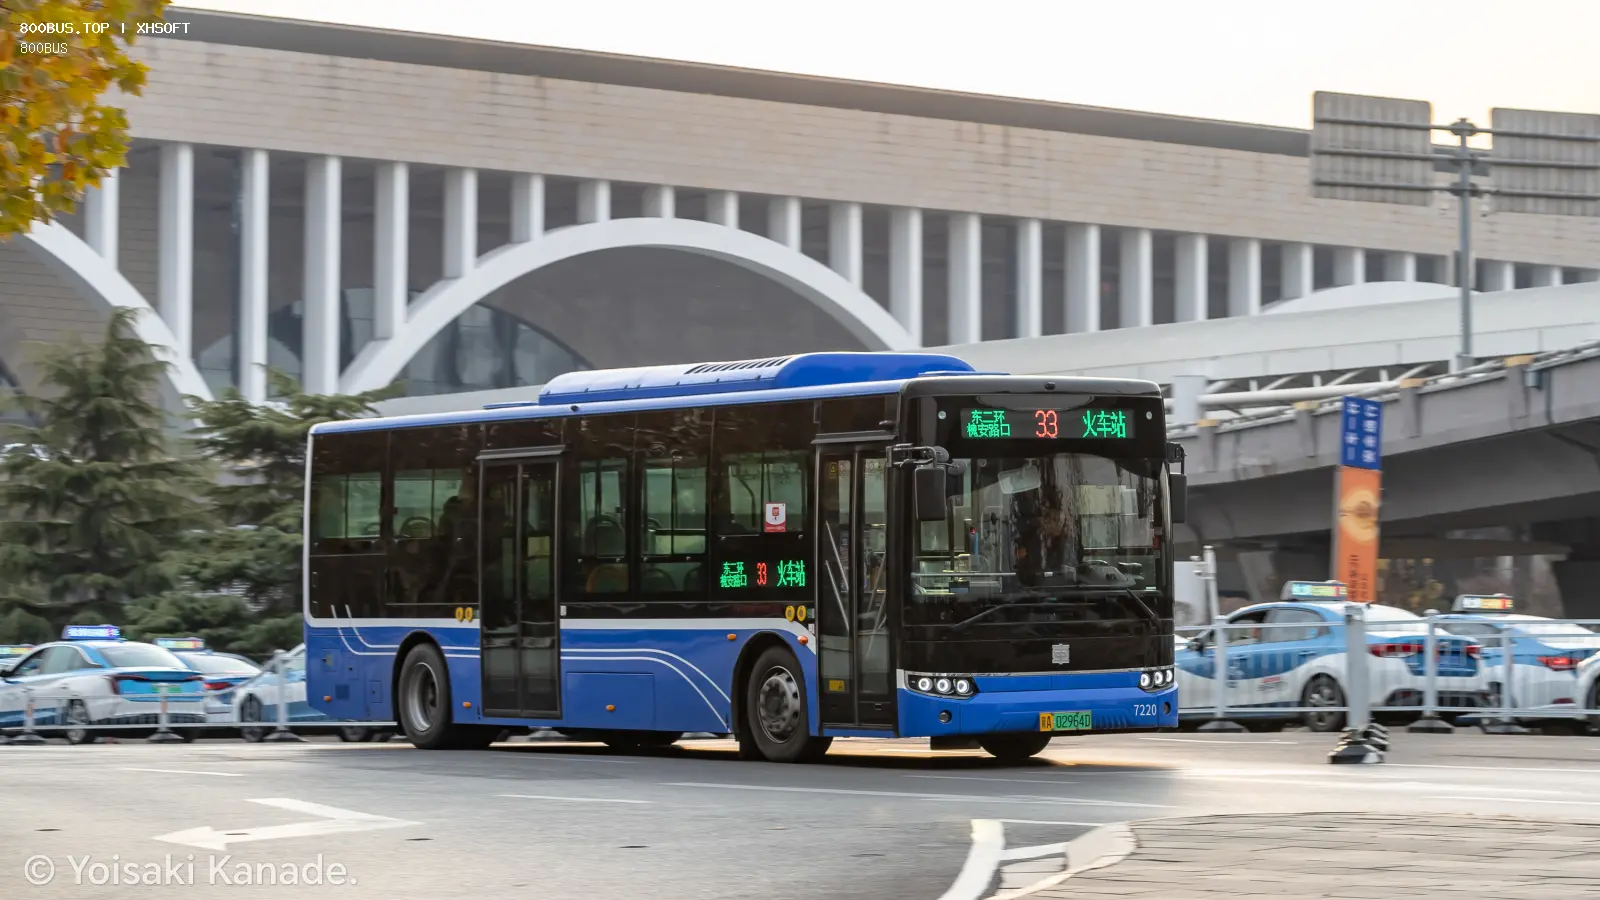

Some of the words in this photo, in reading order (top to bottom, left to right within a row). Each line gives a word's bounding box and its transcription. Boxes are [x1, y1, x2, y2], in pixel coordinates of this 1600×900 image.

[971, 409, 1005, 424] 东二环
[1034, 409, 1058, 438] 33
[1082, 410, 1126, 438] 火车站
[756, 562, 767, 585] 33
[777, 560, 806, 587] 火车站
[1133, 704, 1157, 716] 7220
